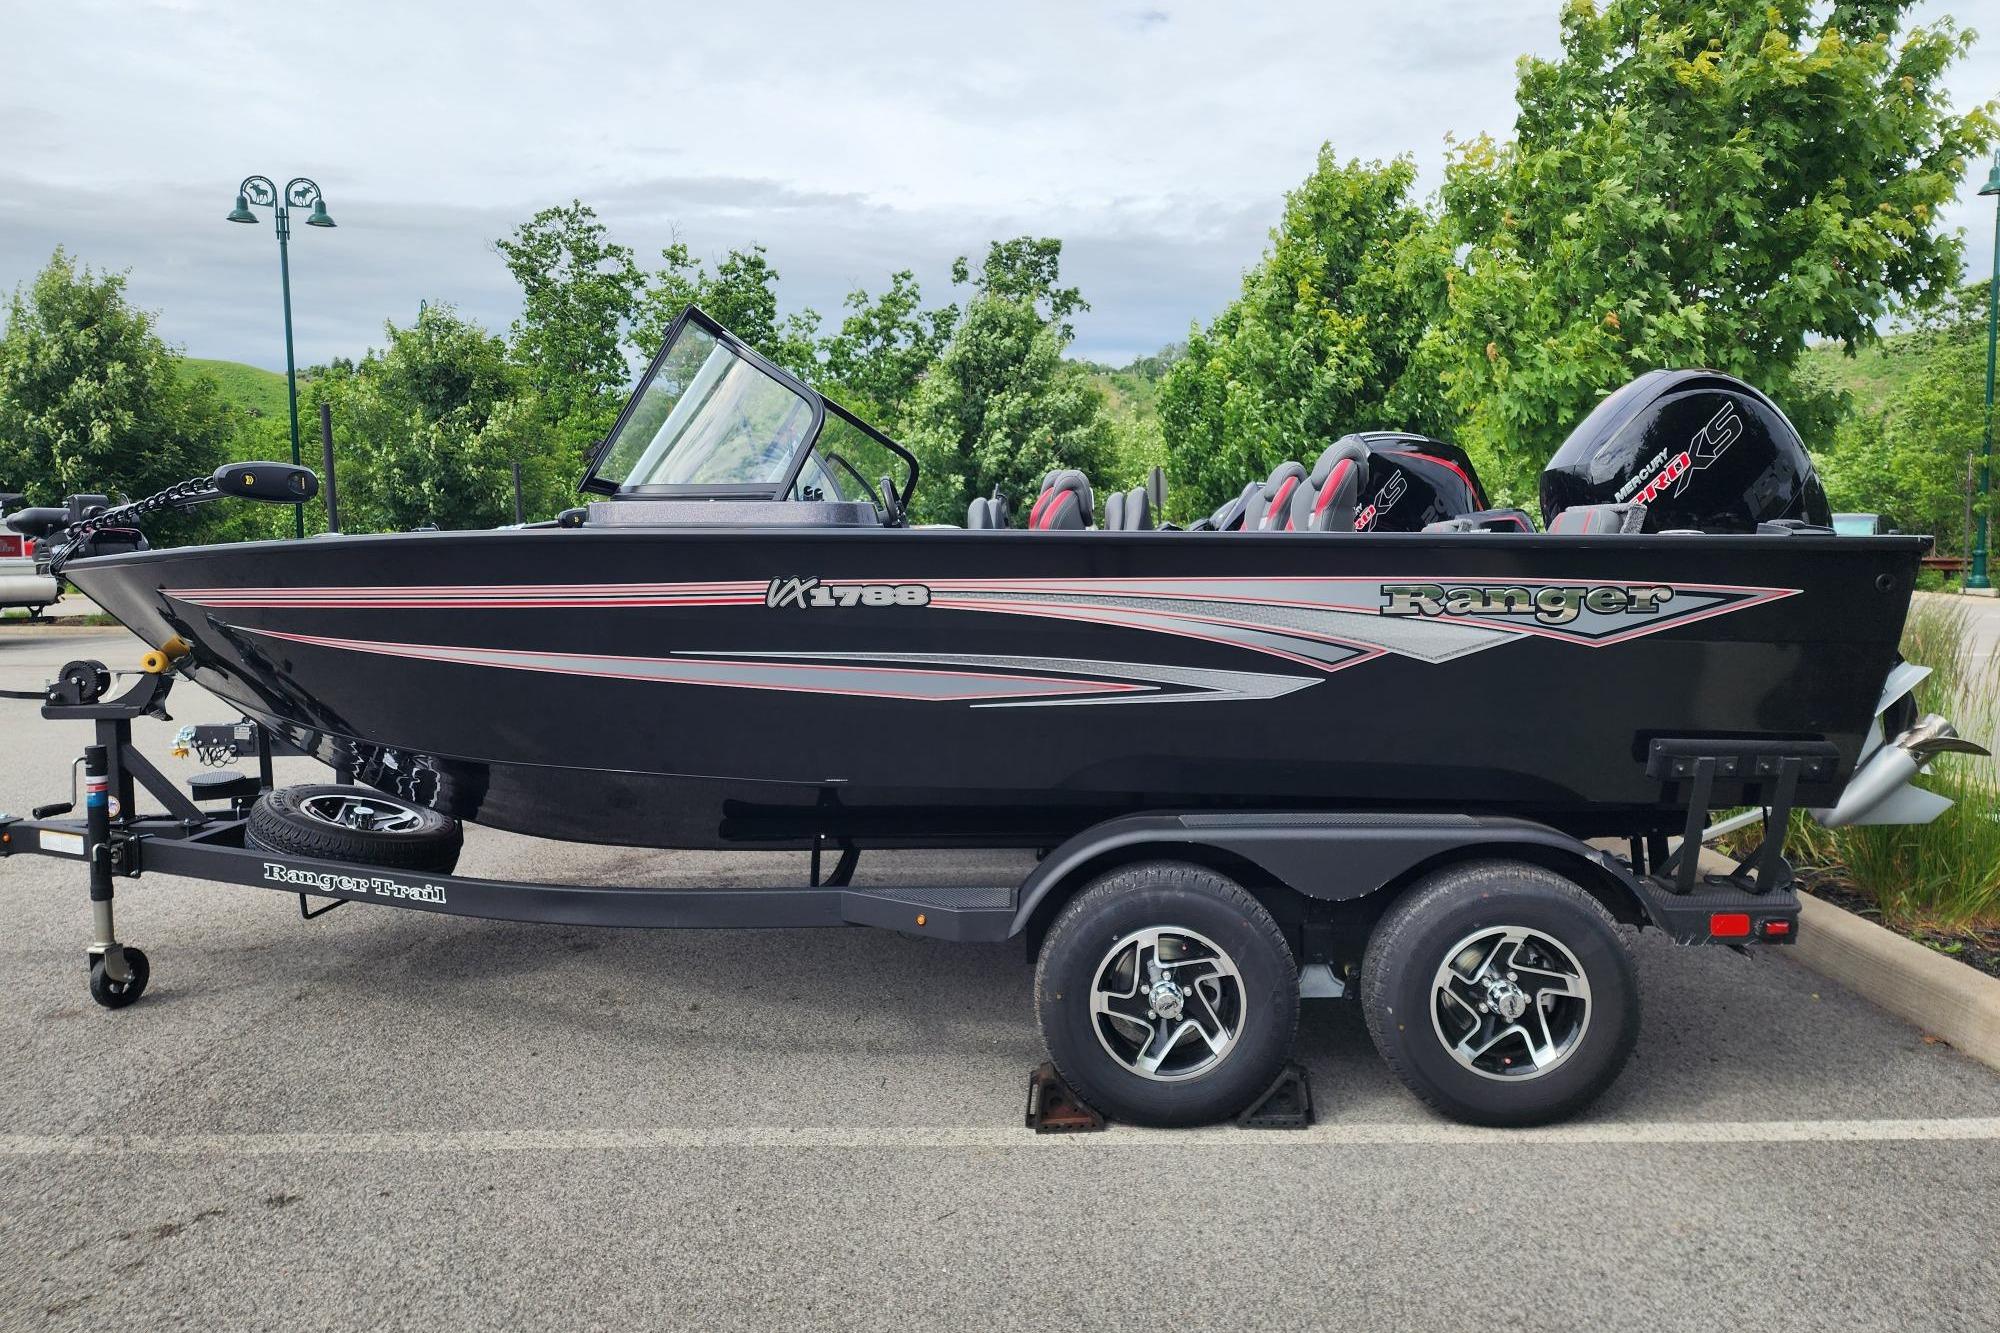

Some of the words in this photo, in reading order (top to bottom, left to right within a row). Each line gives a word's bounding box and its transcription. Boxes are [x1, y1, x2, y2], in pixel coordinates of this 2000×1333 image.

[1673, 400, 1743, 499] XS
[1614, 447, 1668, 503] MERCURY
[766, 576, 931, 609] VX1788
[1380, 584, 1675, 625] Ranger
[263, 862, 369, 892] Ranger
[371, 877, 447, 904] Trail
